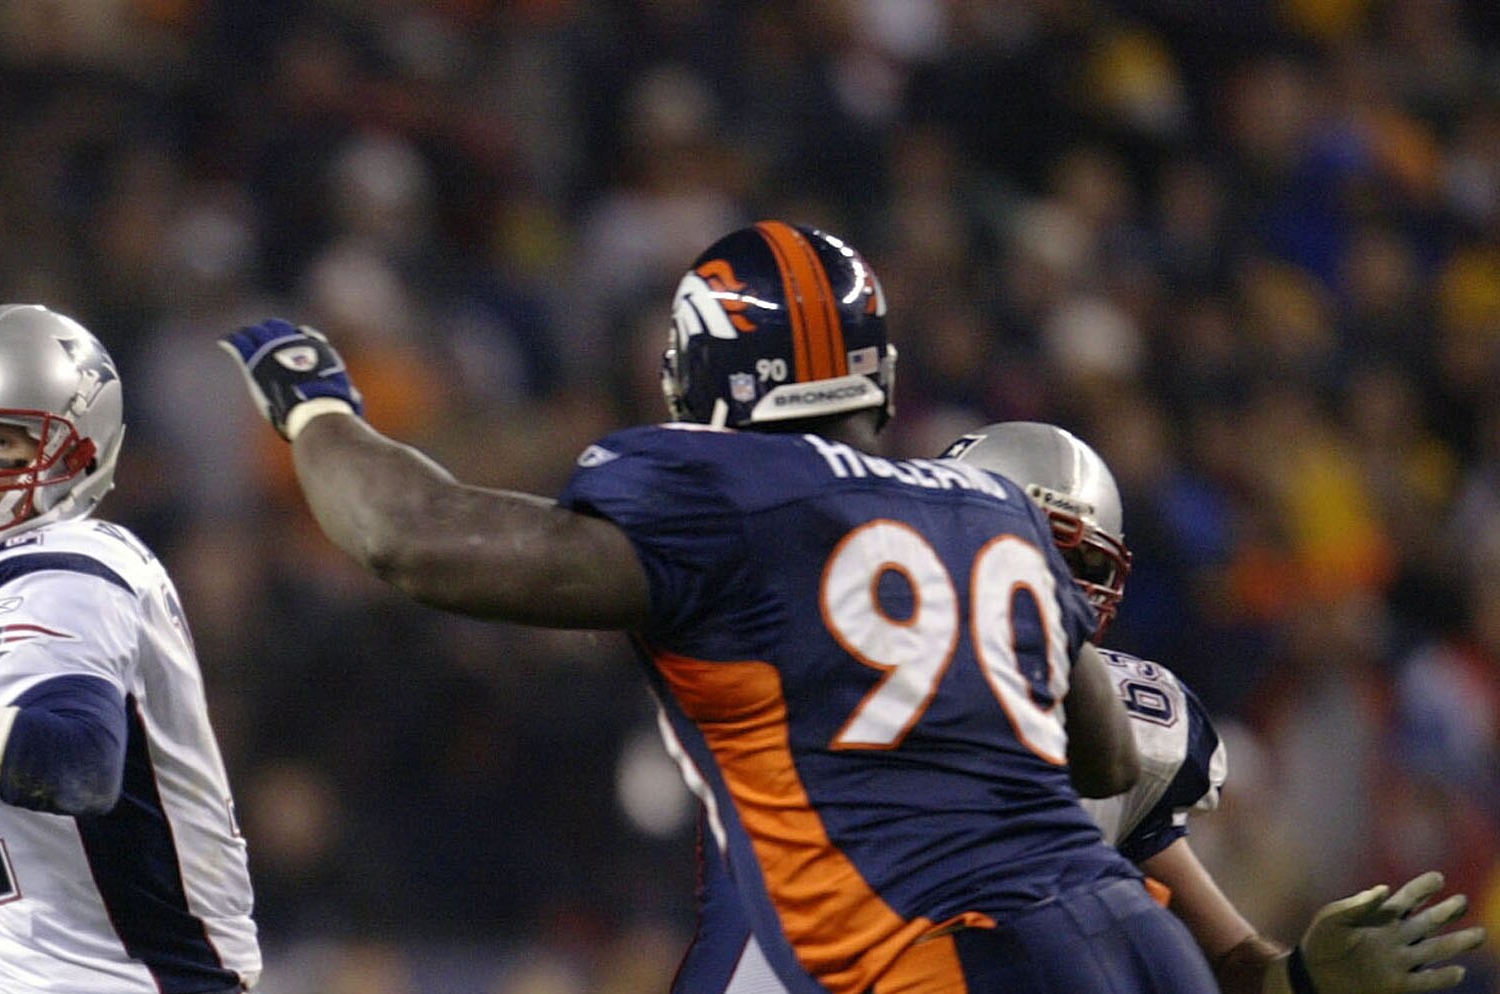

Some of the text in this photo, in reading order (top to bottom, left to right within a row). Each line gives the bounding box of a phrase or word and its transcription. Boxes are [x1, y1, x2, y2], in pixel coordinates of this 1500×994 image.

[755, 358, 787, 382] 90
[774, 382, 868, 407] BRONCOS
[818, 517, 1070, 766] 90
